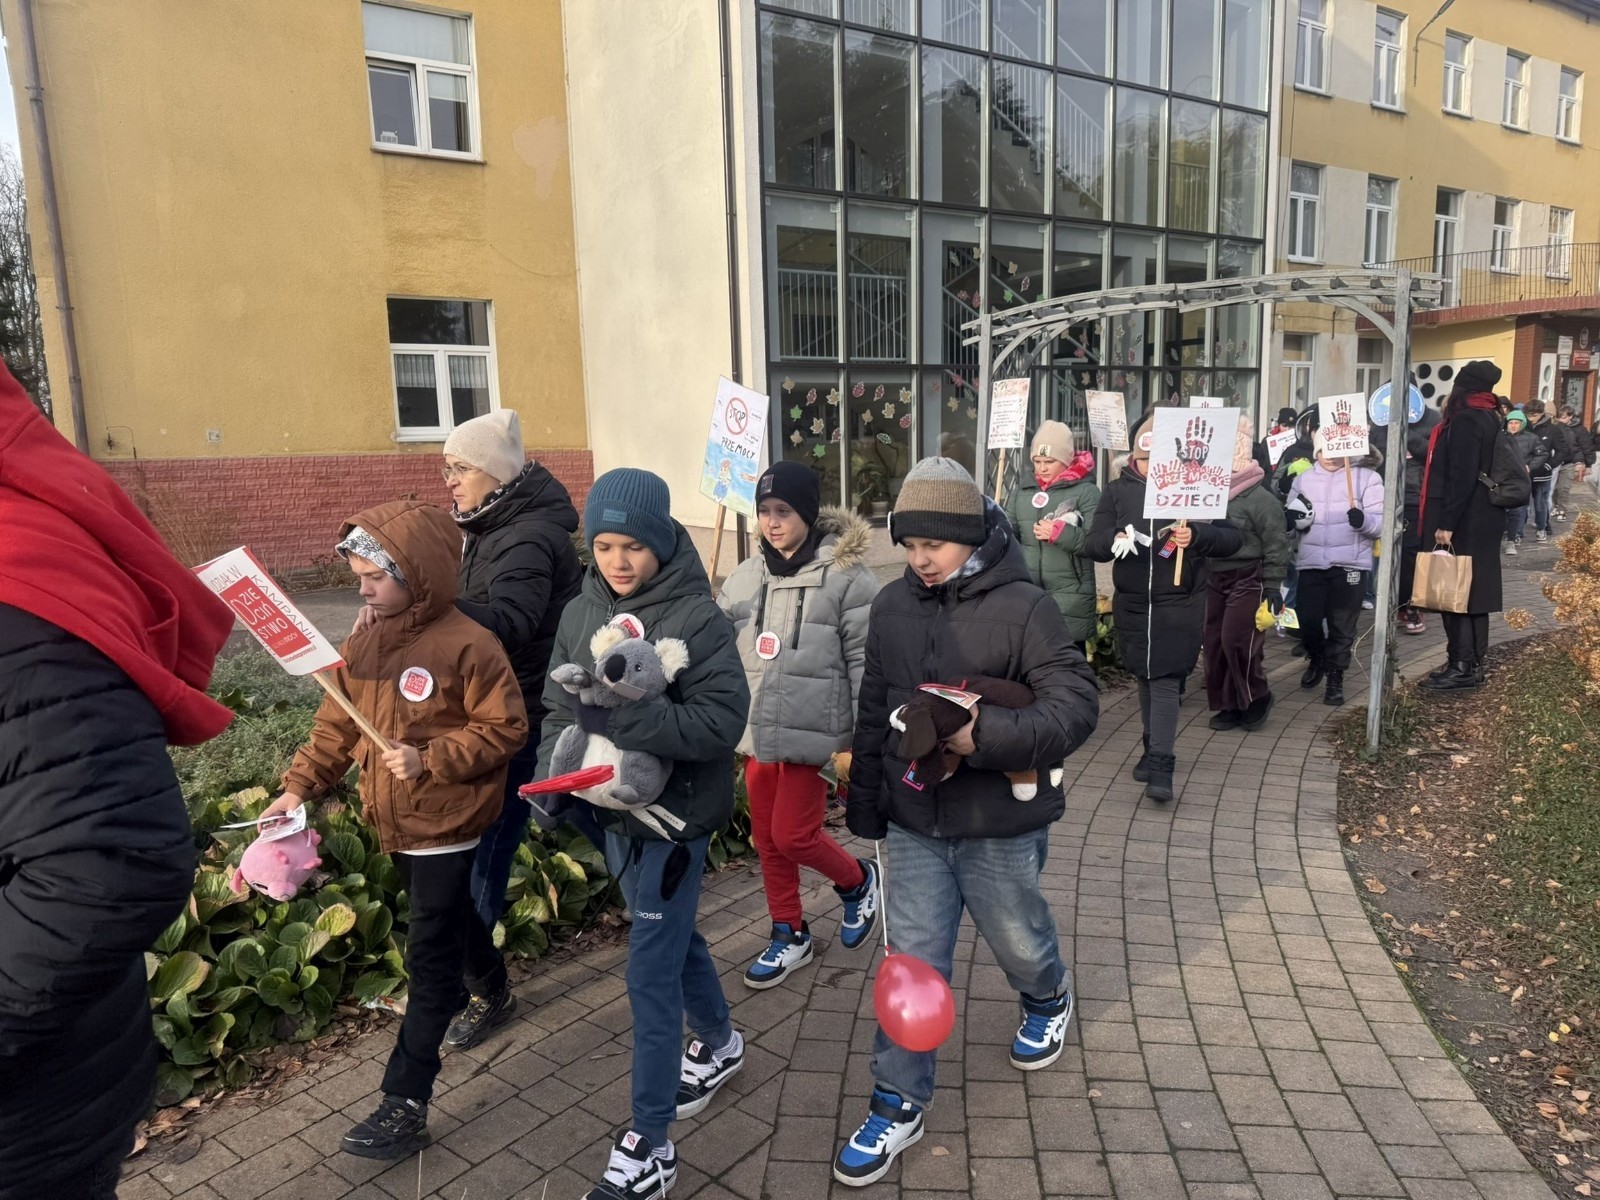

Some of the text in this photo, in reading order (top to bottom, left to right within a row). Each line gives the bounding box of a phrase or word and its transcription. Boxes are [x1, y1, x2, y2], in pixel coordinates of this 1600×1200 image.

[729, 407, 746, 422] STOP
[721, 436, 756, 459] PRZEMOCY
[1182, 445, 1209, 459] STOP
[229, 565, 243, 579] W
[250, 574, 316, 640] KAMPANII
[257, 617, 289, 640] STWO
